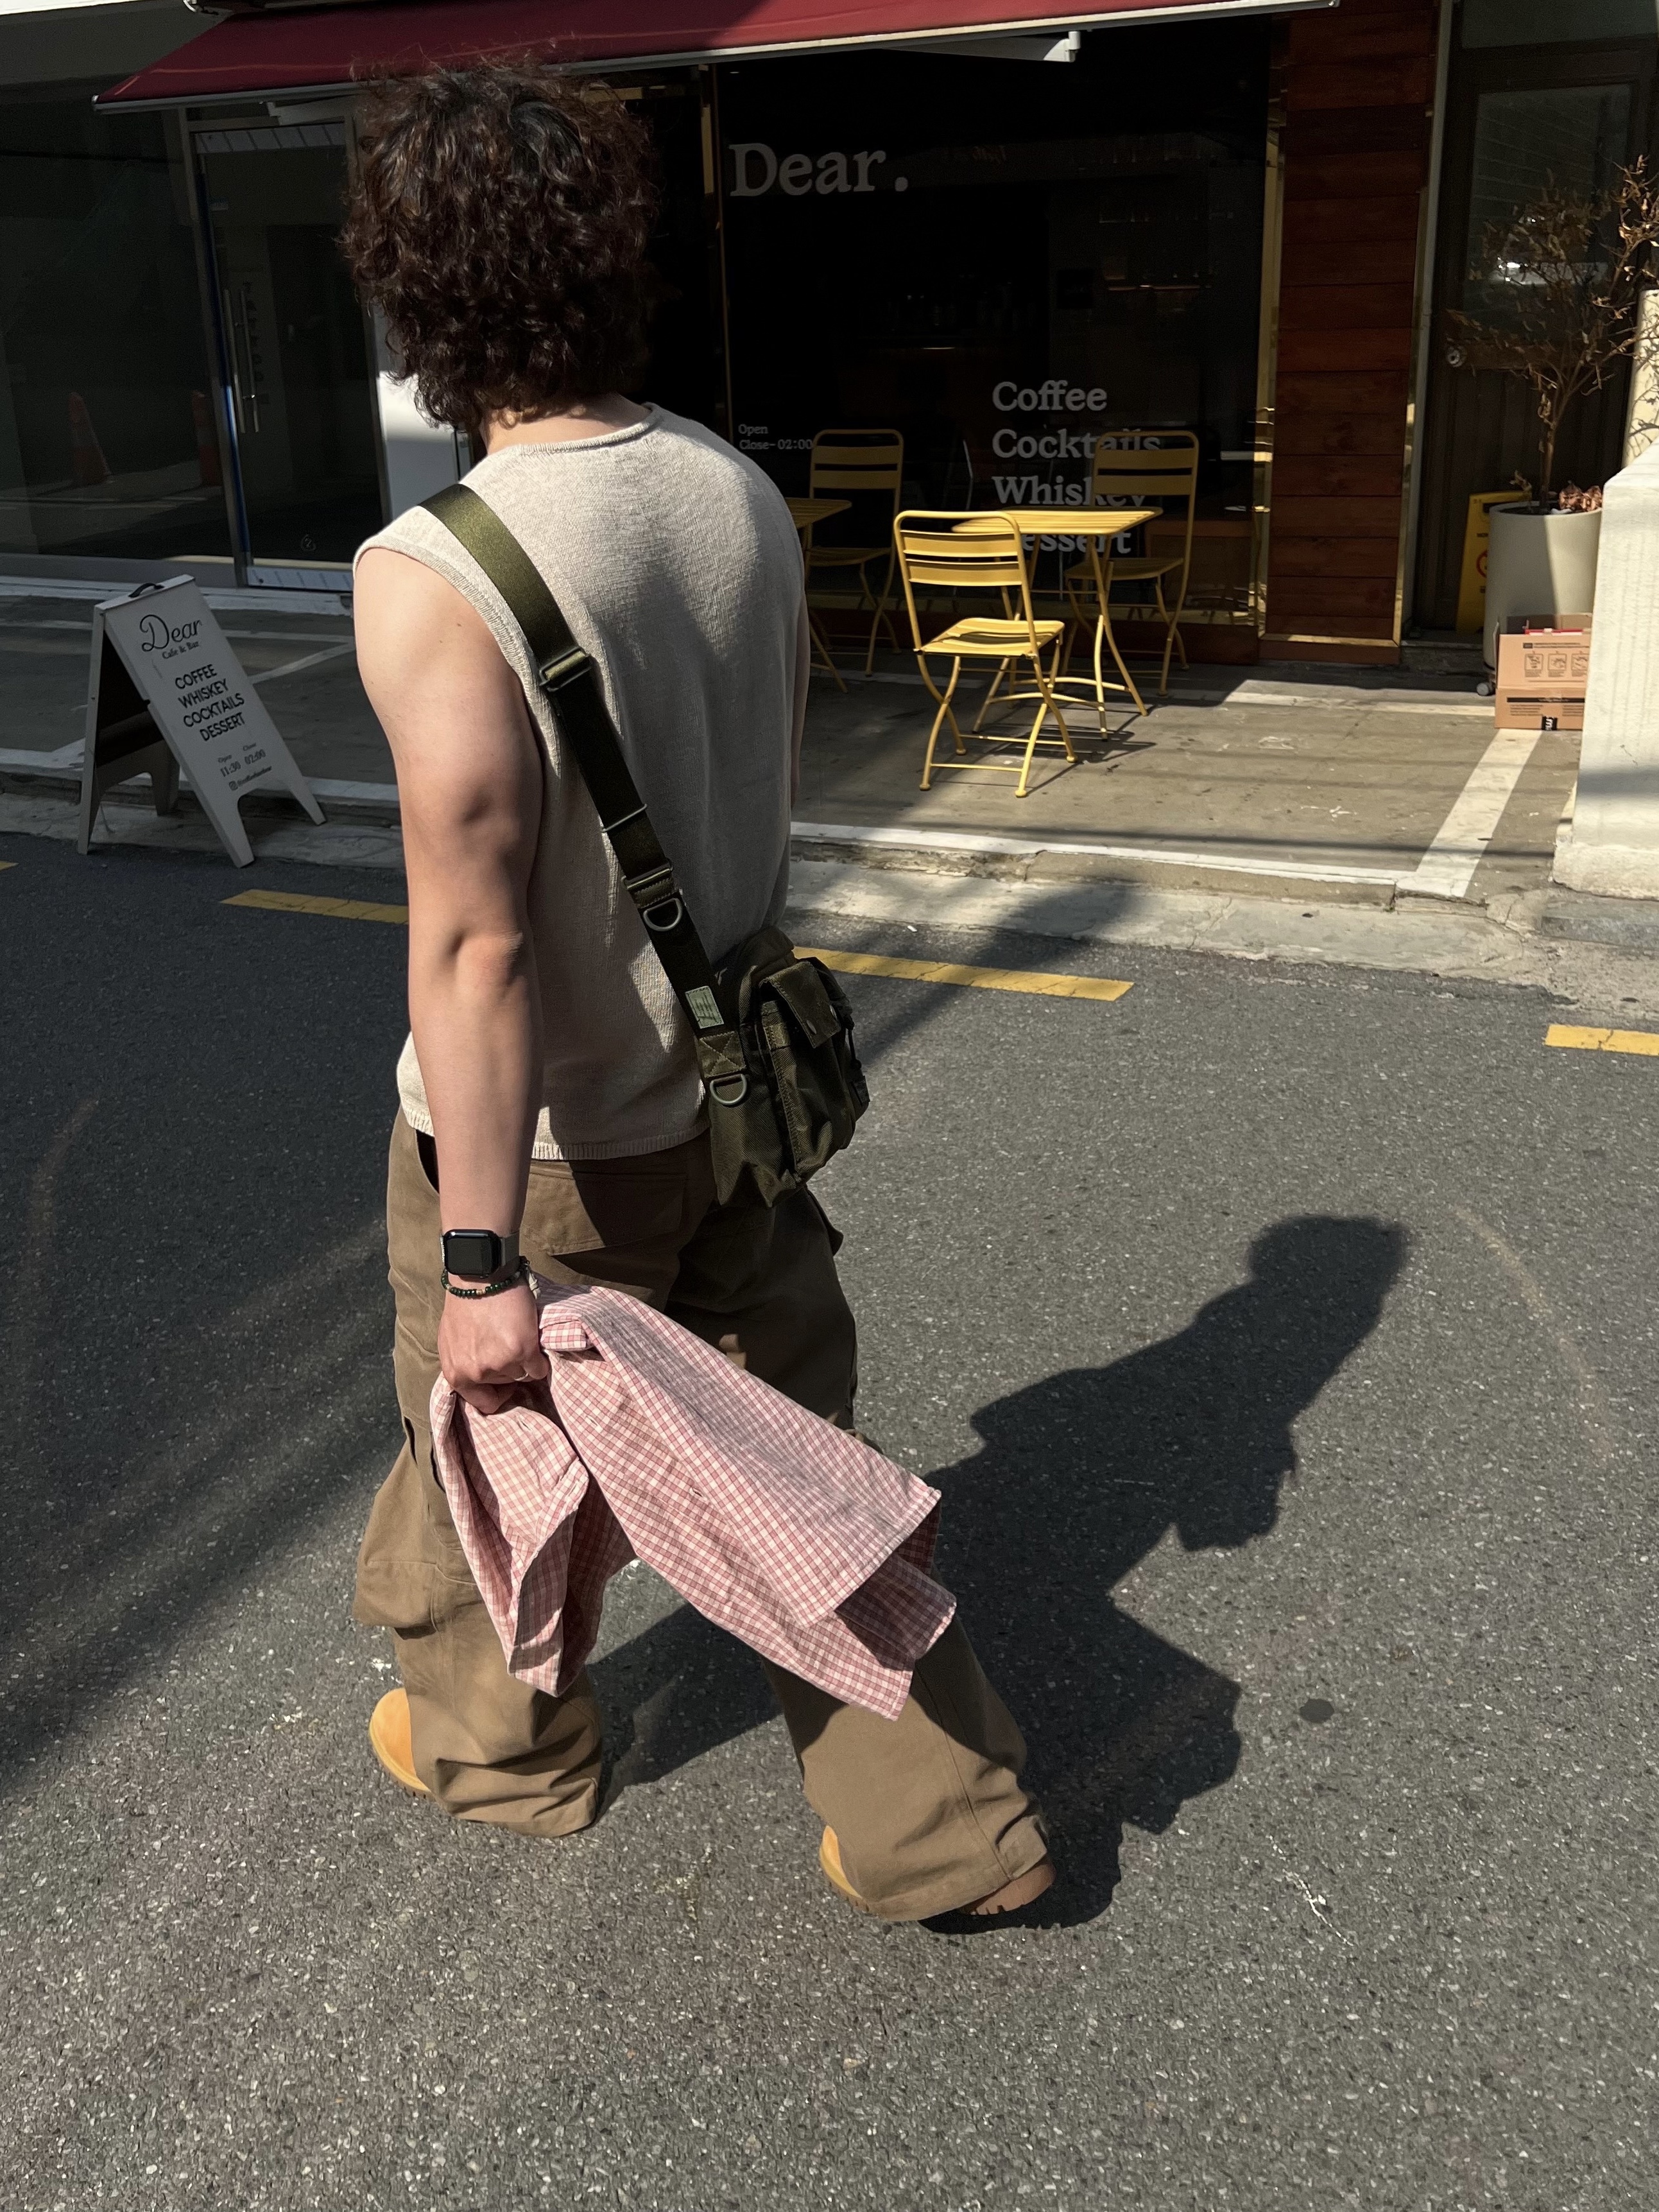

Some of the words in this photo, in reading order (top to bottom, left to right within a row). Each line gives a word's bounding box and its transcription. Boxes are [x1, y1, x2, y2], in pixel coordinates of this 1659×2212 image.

[992, 379, 1108, 411] Coffee
[737, 423, 769, 436] Open
[1020, 530, 1131, 554] essert
[139, 614, 203, 652] Dear
[175, 664, 218, 689] COFFEE
[178, 678, 228, 709] WHISKEY
[183, 693, 245, 727] COCKTAILS
[199, 711, 245, 741] DESSERT
